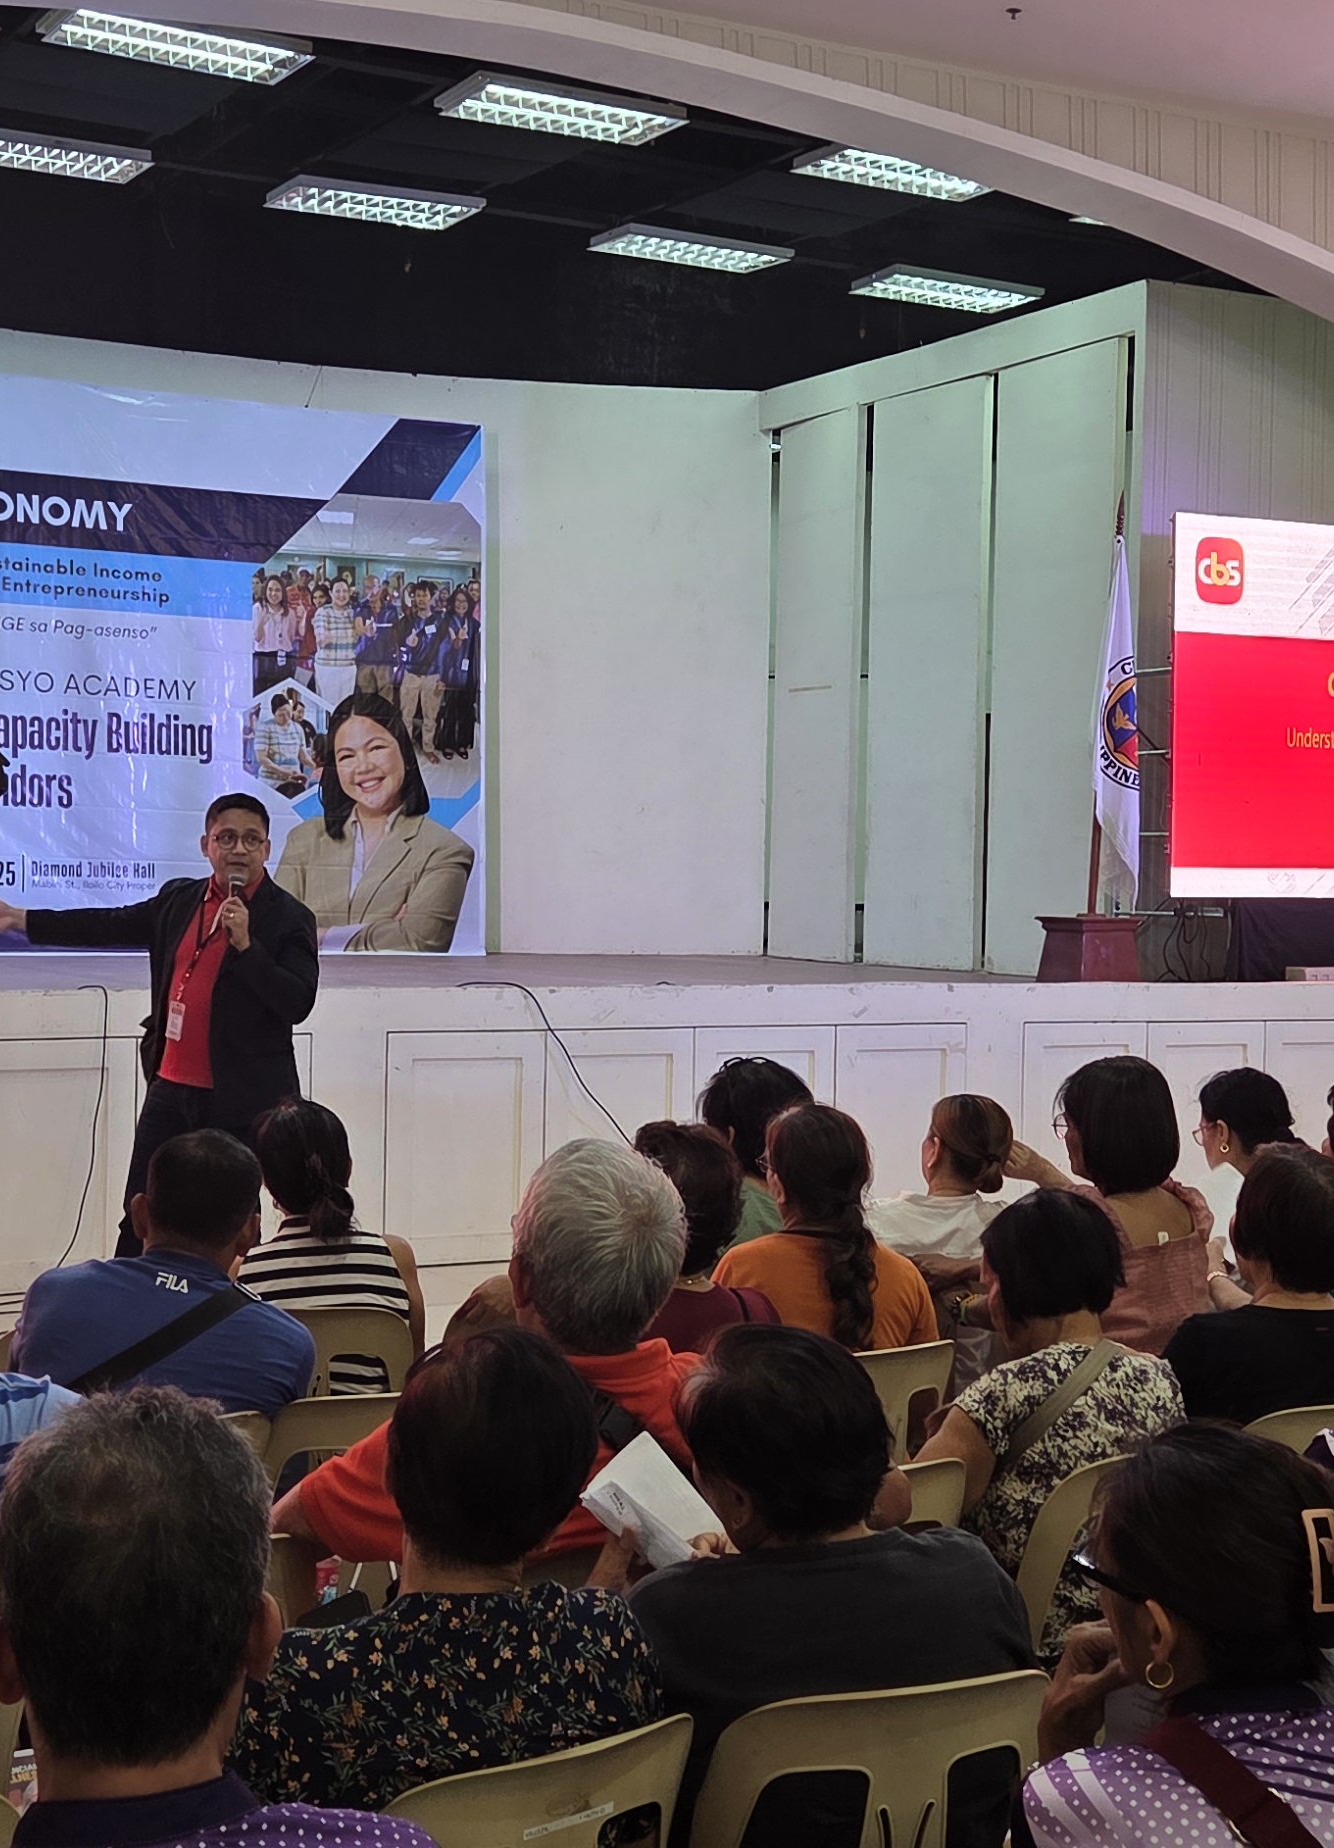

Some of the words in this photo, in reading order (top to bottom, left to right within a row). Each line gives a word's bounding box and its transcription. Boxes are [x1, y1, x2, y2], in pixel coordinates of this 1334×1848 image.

[93, 562, 163, 582] Income
[1198, 551, 1242, 587] cbs
[2, 576, 170, 608] Entrepreneurship
[29, 620, 48, 633] sa
[63, 673, 197, 701] ACADEMY
[106, 711, 213, 765] Building
[31, 860, 83, 878] Diamond
[86, 861, 129, 879] Jubilee
[133, 862, 155, 879] Hall
[155, 1271, 189, 1294] FILA
